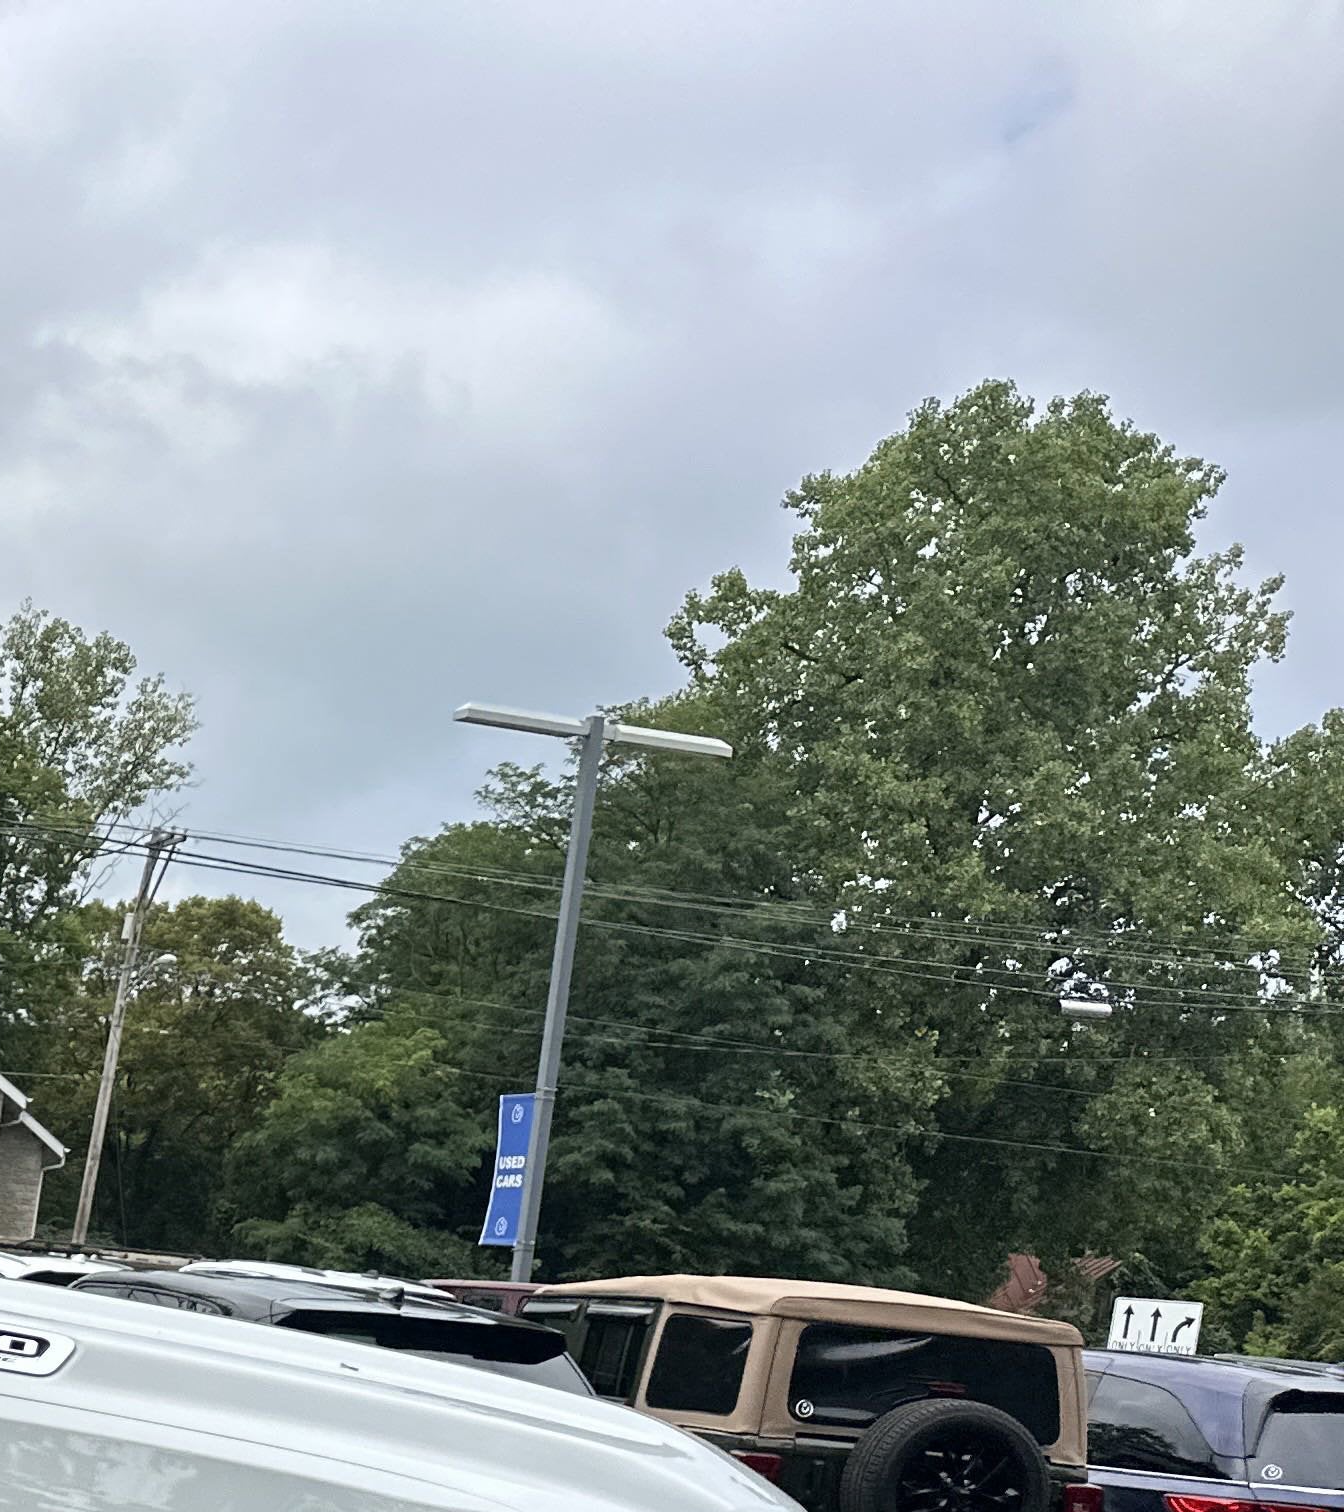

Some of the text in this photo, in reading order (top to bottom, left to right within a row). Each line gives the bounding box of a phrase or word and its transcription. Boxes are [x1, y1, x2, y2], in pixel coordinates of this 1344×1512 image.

[499, 1155, 525, 1170] USED
[496, 1174, 523, 1188] CARS
[1112, 1340, 1137, 1351] ONLY
[1167, 1344, 1193, 1355] ONLY
